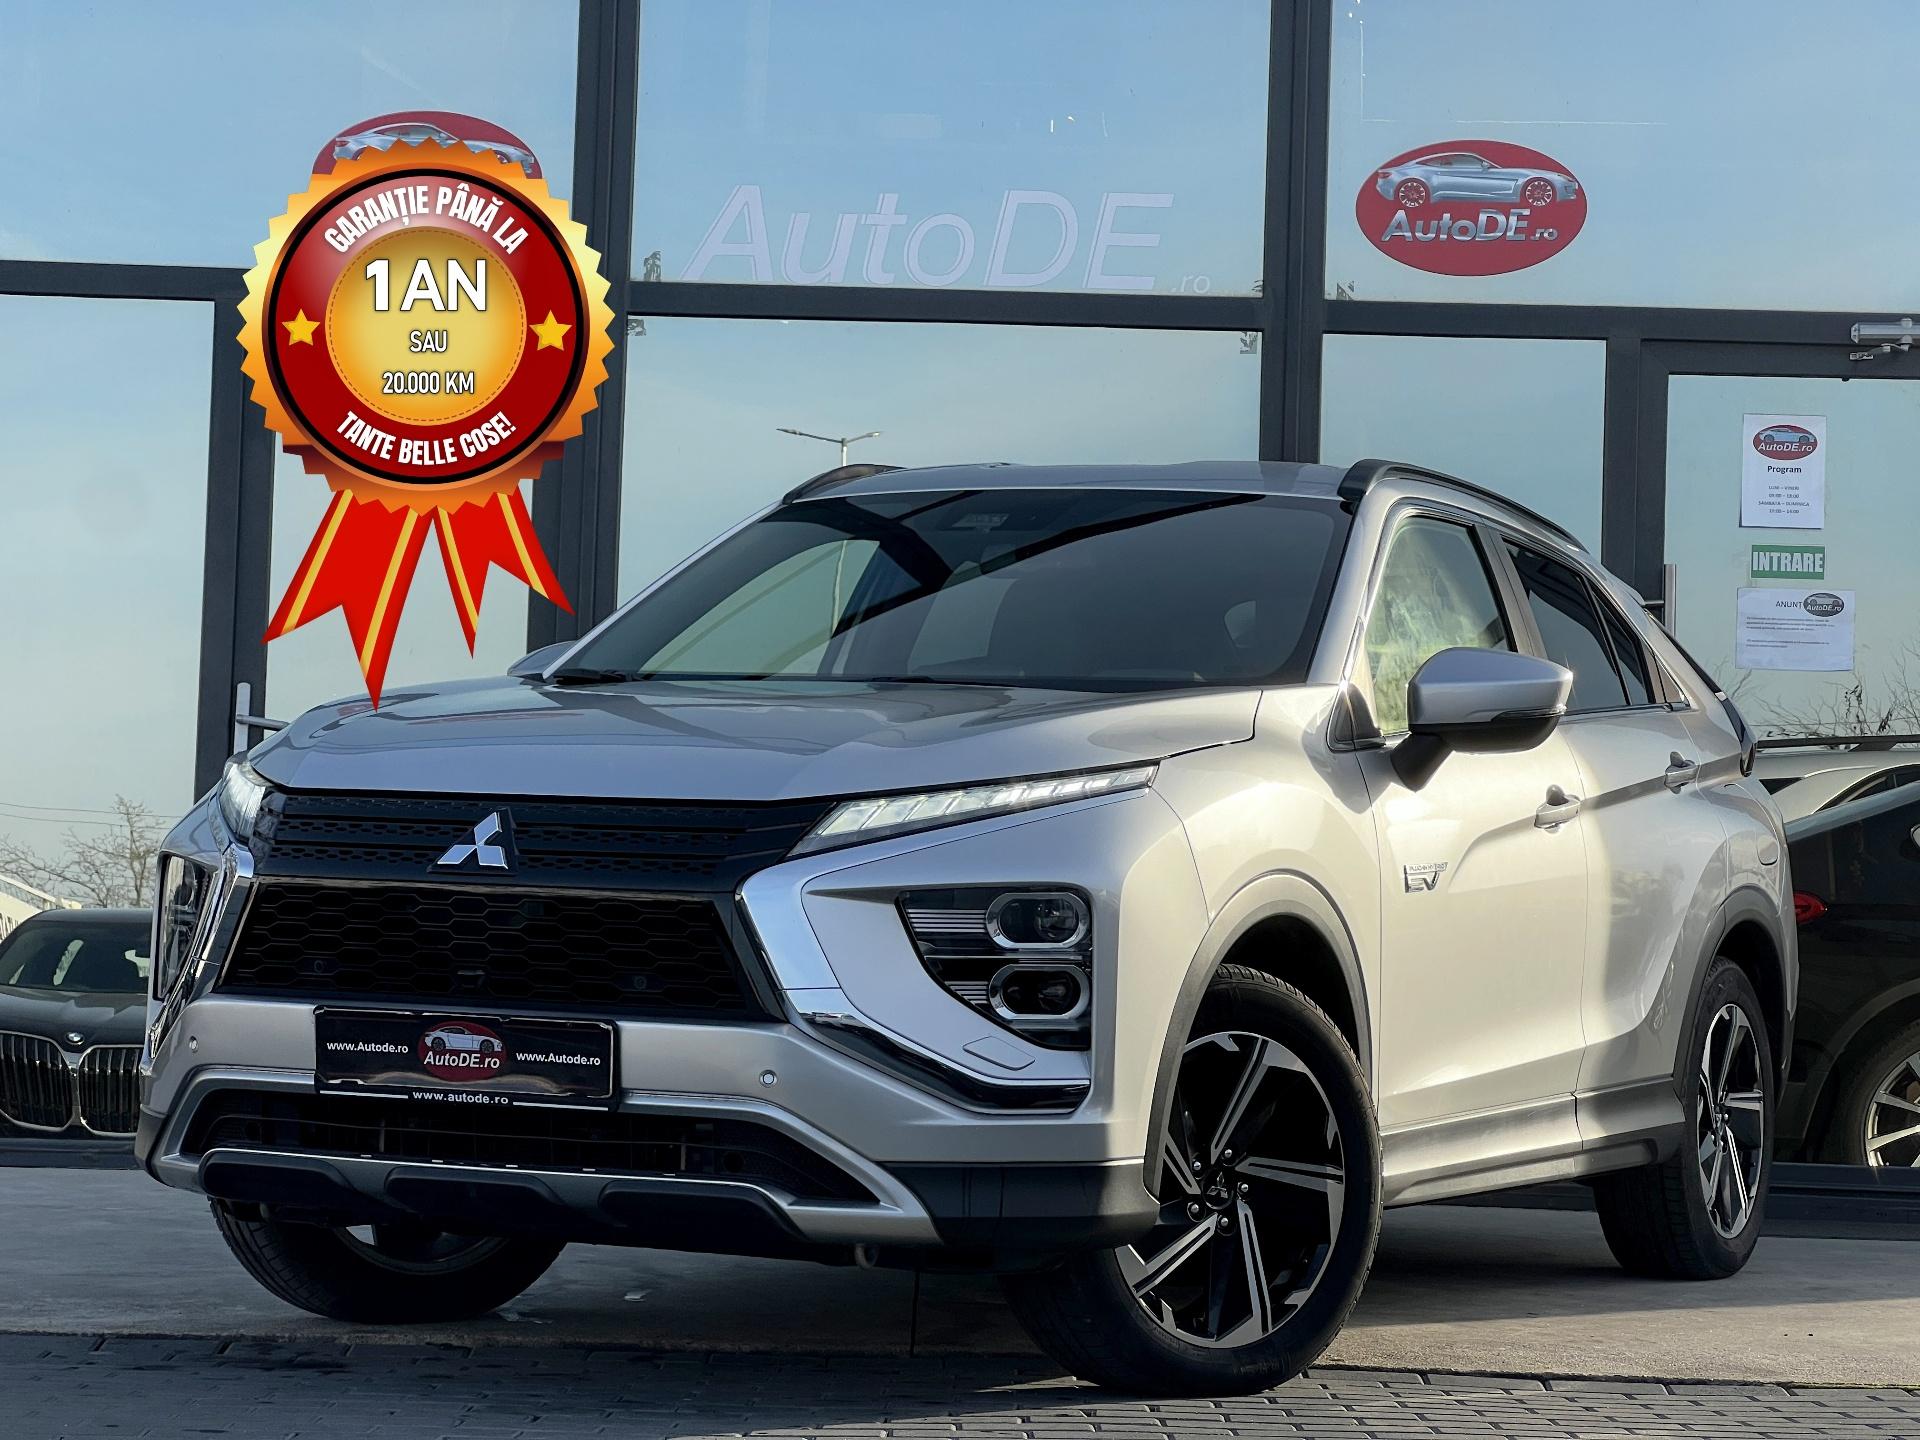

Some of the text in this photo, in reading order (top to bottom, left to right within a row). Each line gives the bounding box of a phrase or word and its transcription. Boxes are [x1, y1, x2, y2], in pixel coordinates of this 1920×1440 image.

[1767, 465, 1802, 474] Program
[1752, 551, 1824, 573] INTRARE
[326, 1040, 409, 1055] www.Autode.ro
[423, 1050, 500, 1069] AutoDE.ro
[515, 1052, 601, 1066] www.Autode.ro
[412, 1090, 509, 1105] www.autode.ro
